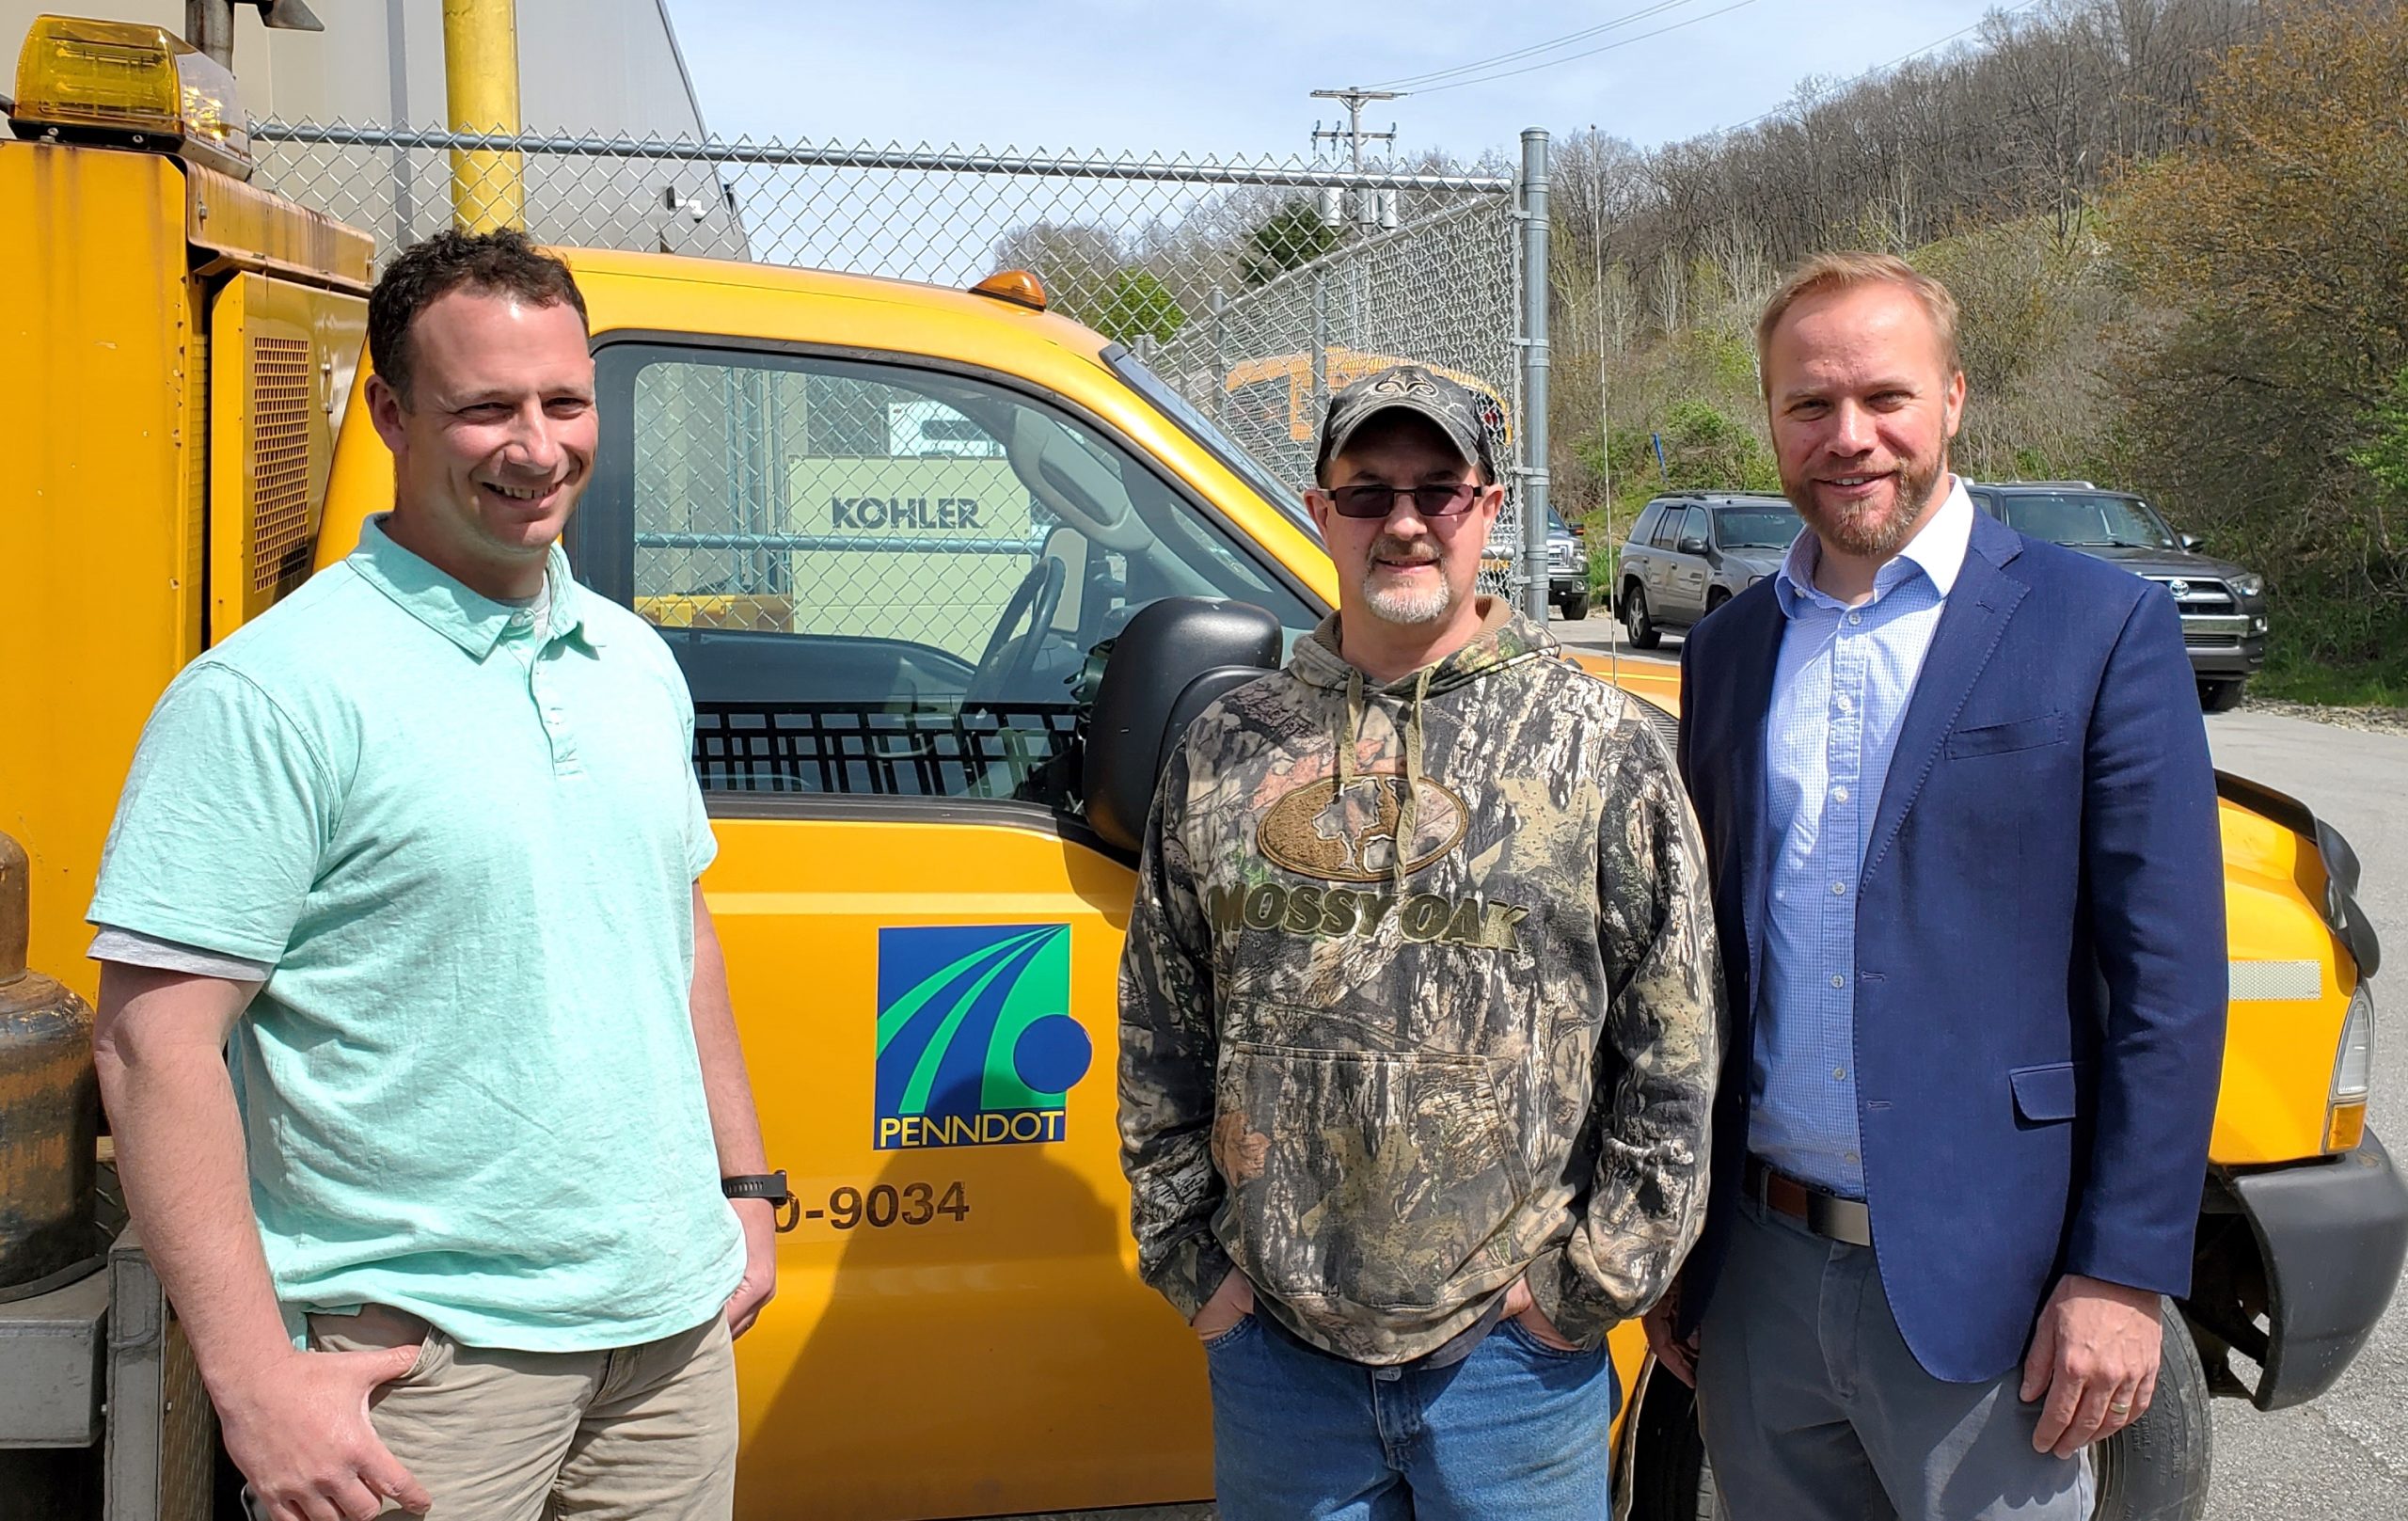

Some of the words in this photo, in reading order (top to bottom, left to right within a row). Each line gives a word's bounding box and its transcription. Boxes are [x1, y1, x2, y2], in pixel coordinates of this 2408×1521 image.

[832, 497, 984, 530] KOHLER
[1207, 880, 1399, 939] MOSSY
[1399, 893, 1530, 953] OAK
[879, 1110, 1065, 1148] PENNDOT
